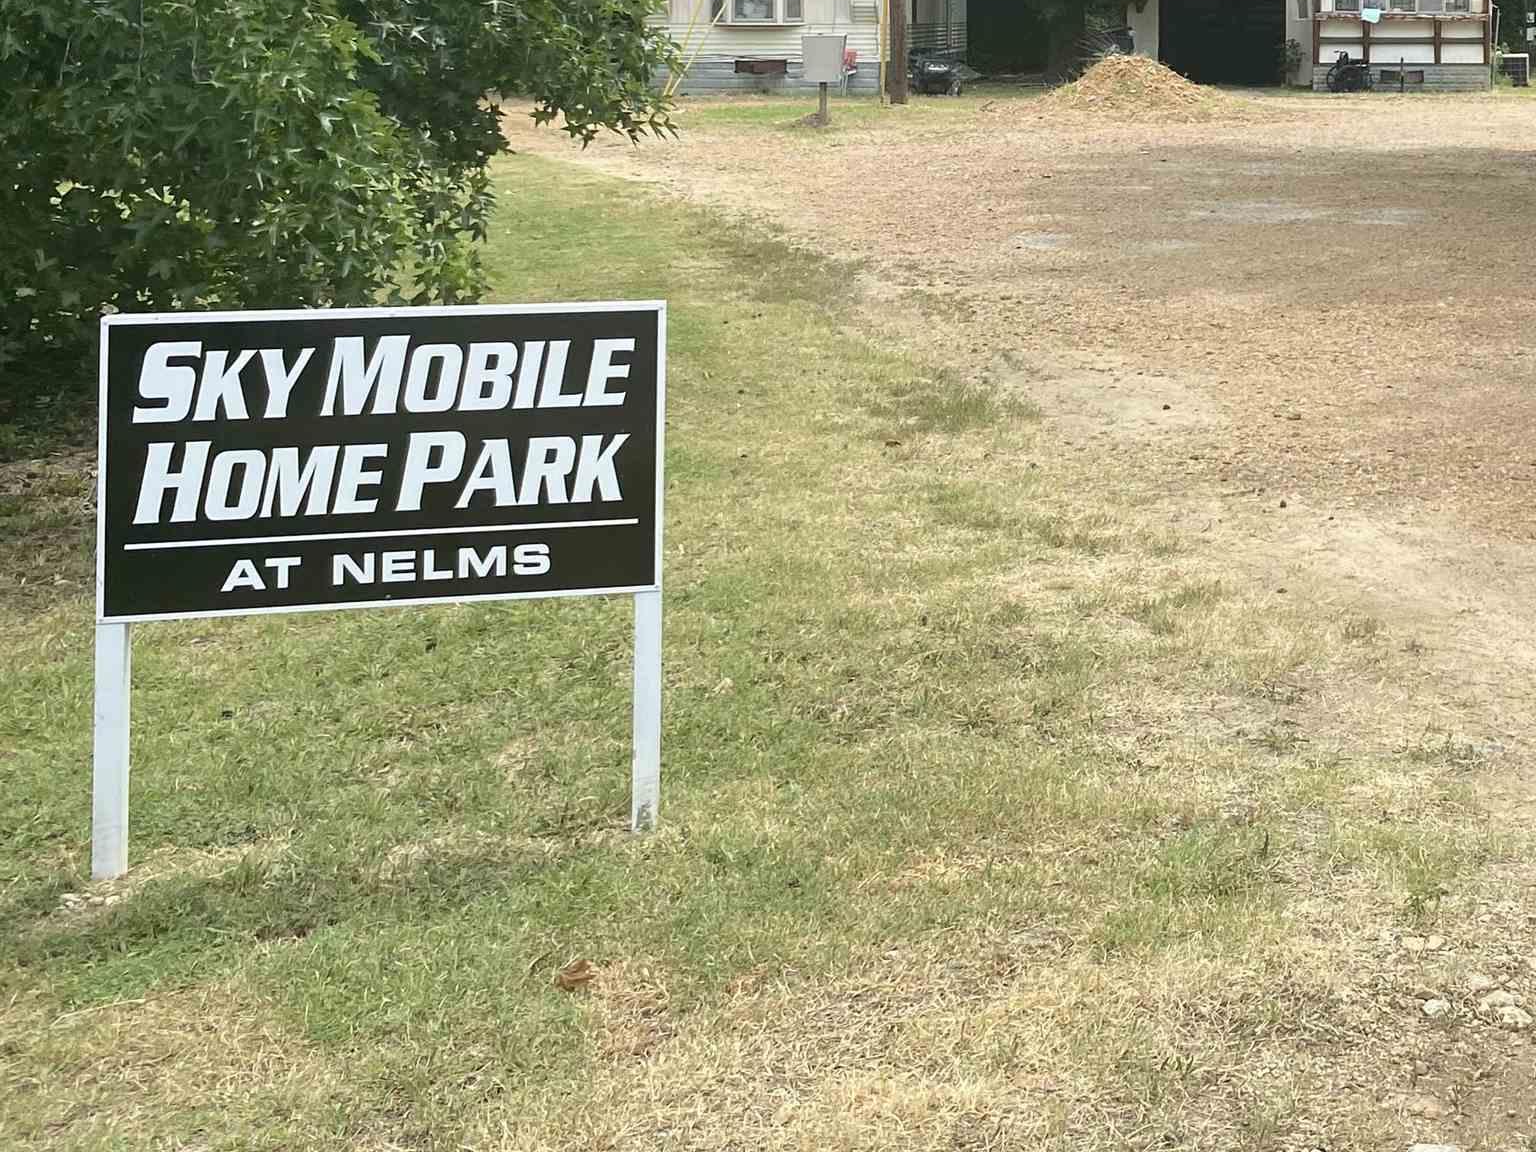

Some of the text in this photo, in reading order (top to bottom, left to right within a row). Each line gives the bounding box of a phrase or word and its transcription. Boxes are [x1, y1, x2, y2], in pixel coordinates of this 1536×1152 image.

[132, 335, 635, 423] SKY MOBILE
[132, 430, 631, 525] HOME PARK
[220, 543, 550, 592] AT NELMS
